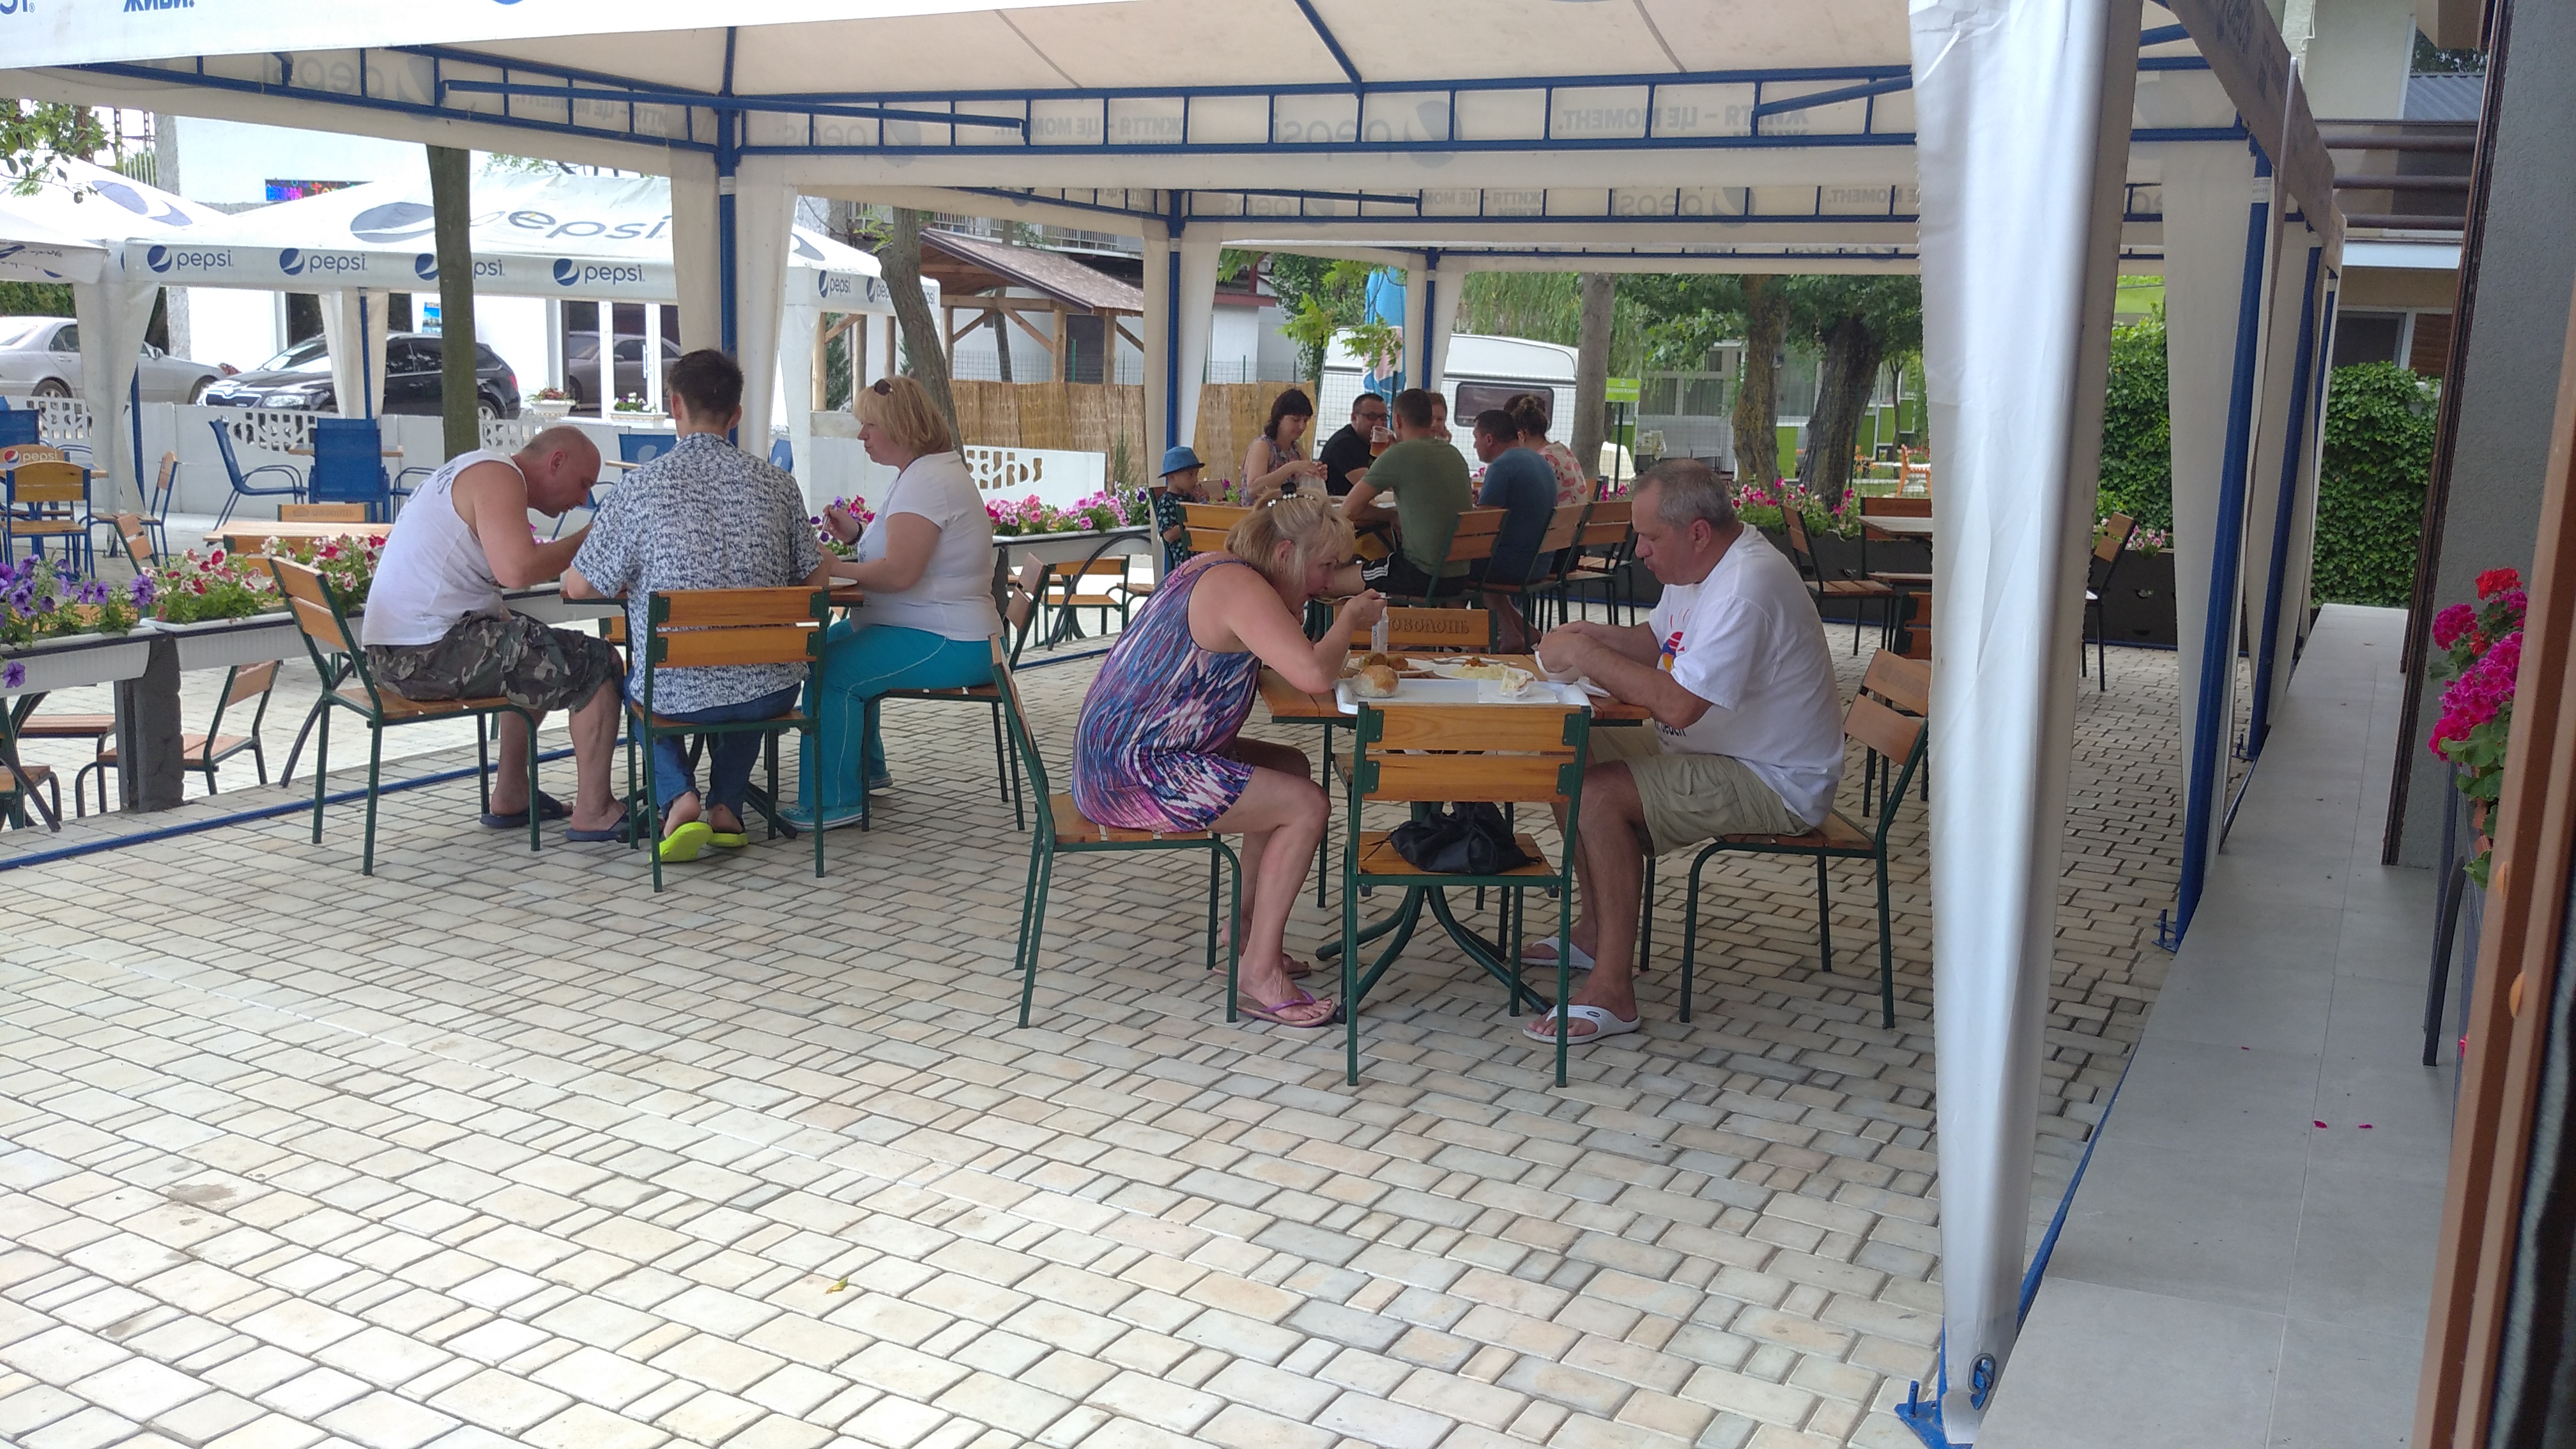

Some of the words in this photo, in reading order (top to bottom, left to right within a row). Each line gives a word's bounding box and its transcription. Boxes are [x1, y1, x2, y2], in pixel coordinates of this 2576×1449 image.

[177, 250, 232, 270] pepsi
[310, 254, 366, 273] pepsi
[473, 259, 503, 279] psi
[585, 264, 643, 285] pepsi
[830, 277, 851, 296] pepsi
[877, 284, 890, 300] pep
[23, 451, 57, 463] pepsi
